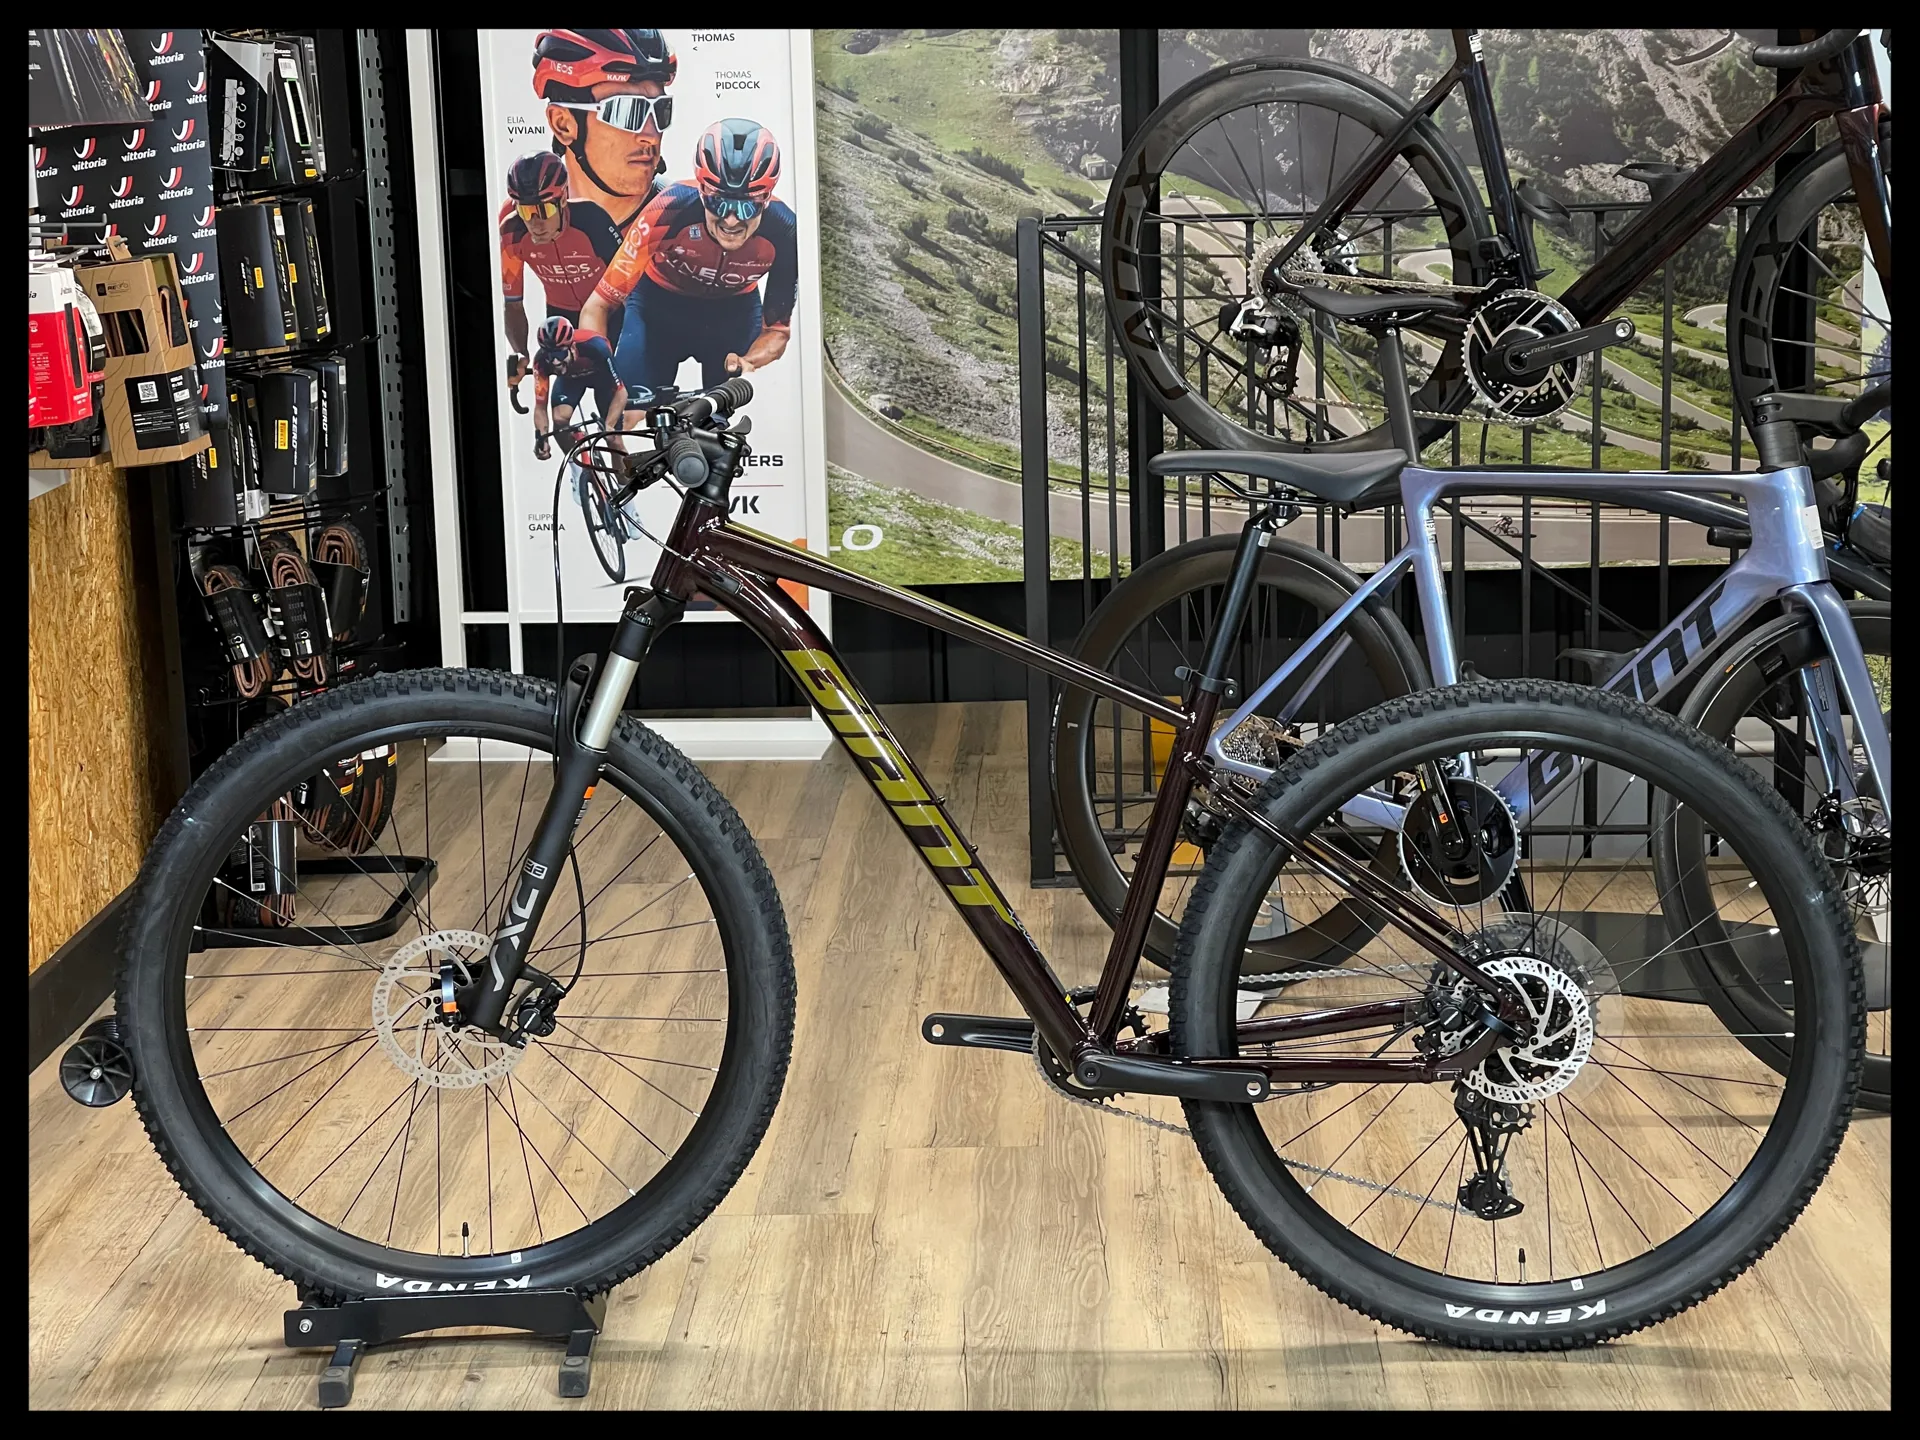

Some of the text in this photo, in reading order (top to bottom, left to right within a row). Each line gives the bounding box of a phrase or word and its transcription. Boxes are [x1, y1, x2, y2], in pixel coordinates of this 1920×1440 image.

[692, 33, 735, 42] THOMAS
[149, 52, 185, 66] vittoria
[551, 61, 573, 75] INEOS
[715, 71, 752, 79] THOMAS
[715, 81, 761, 90] PIDCOCK
[507, 116, 525, 124] ELIA
[508, 126, 545, 135] VIVIANI
[170, 140, 206, 153] vittoria
[121, 149, 156, 163] vittoria
[72, 158, 107, 172] vittoria
[158, 187, 194, 201] vittoria
[109, 196, 144, 210] vittoria
[60, 204, 95, 219] vittoria
[142, 234, 178, 248] vittoria
[536, 263, 591, 275] INEOS
[180, 272, 215, 286] vittoria
[781, 649, 1019, 929] GIANT
[376, 1272, 531, 1293] KENDA
[1445, 1299, 1607, 1325] KENDA
